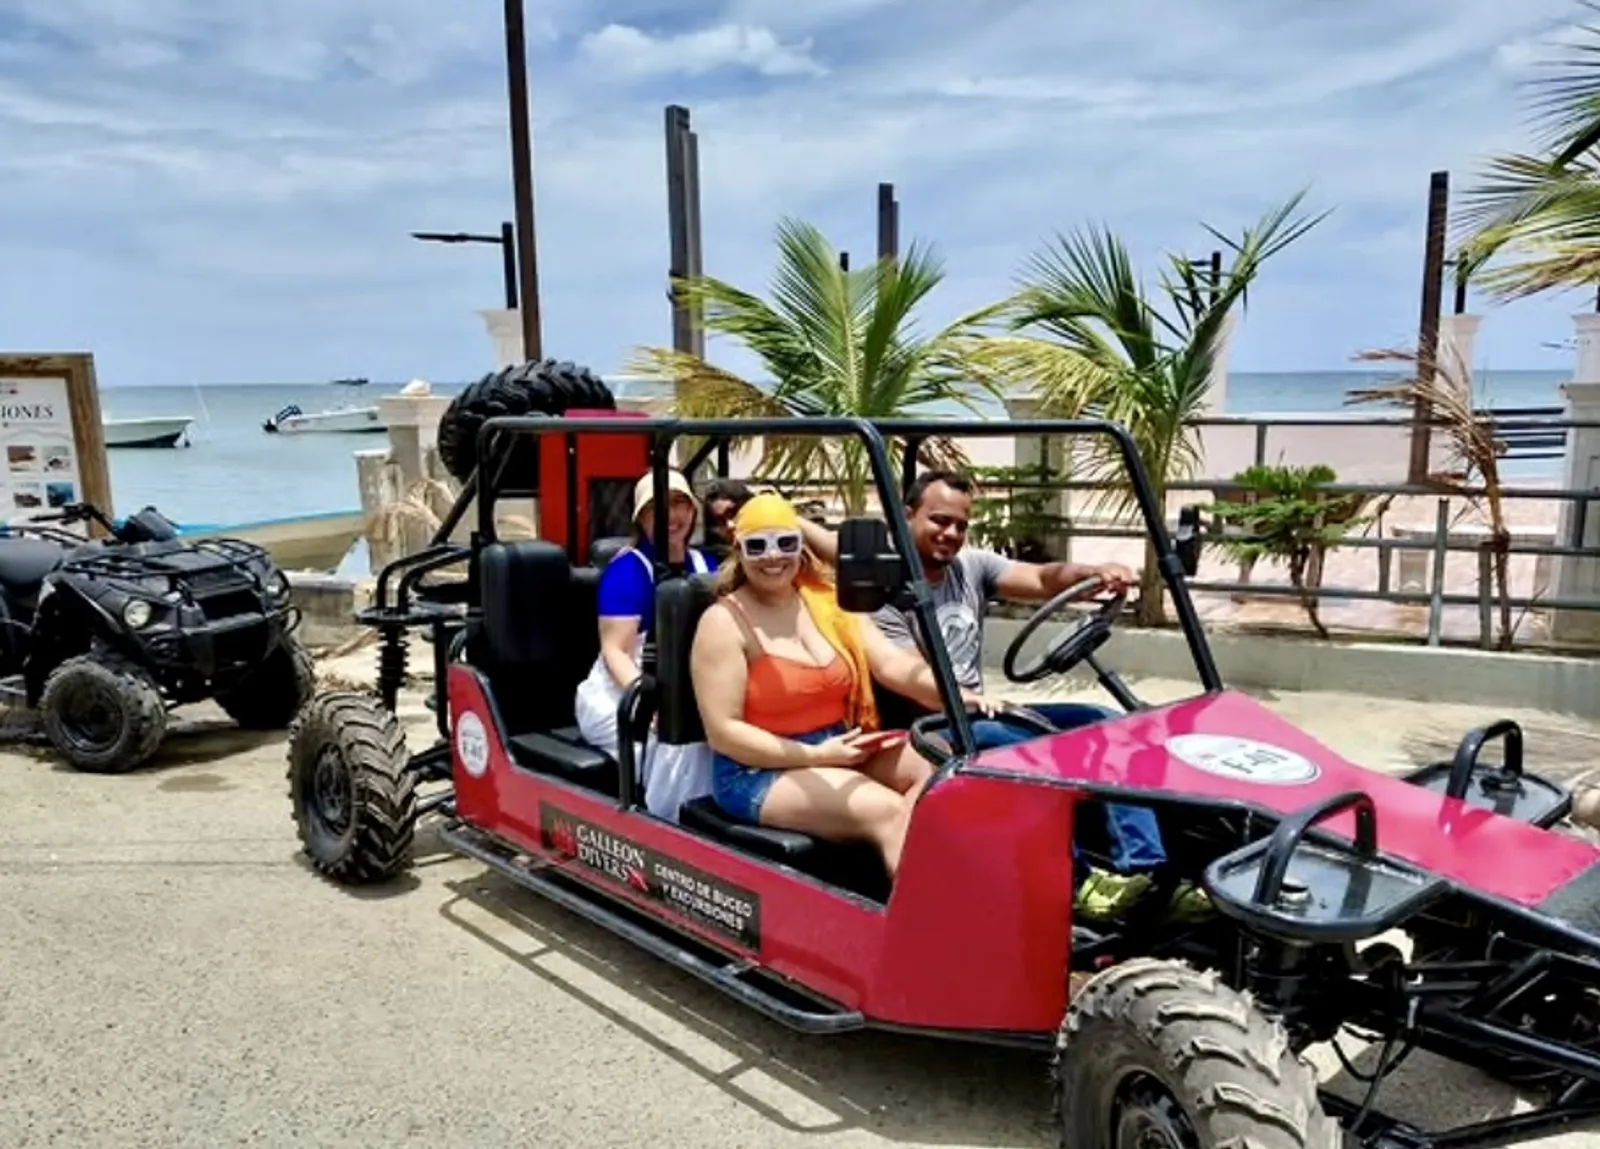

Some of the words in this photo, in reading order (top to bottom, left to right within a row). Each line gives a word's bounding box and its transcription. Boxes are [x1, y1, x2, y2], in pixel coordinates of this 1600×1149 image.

[577, 824, 645, 869] GALLEON
[578, 843, 629, 881] DIVERS
[654, 863, 695, 891] CENTRO
[696, 881, 711, 899] DE
[713, 889, 753, 918] BUCEO
[671, 885, 743, 931] EXCURSIONES
